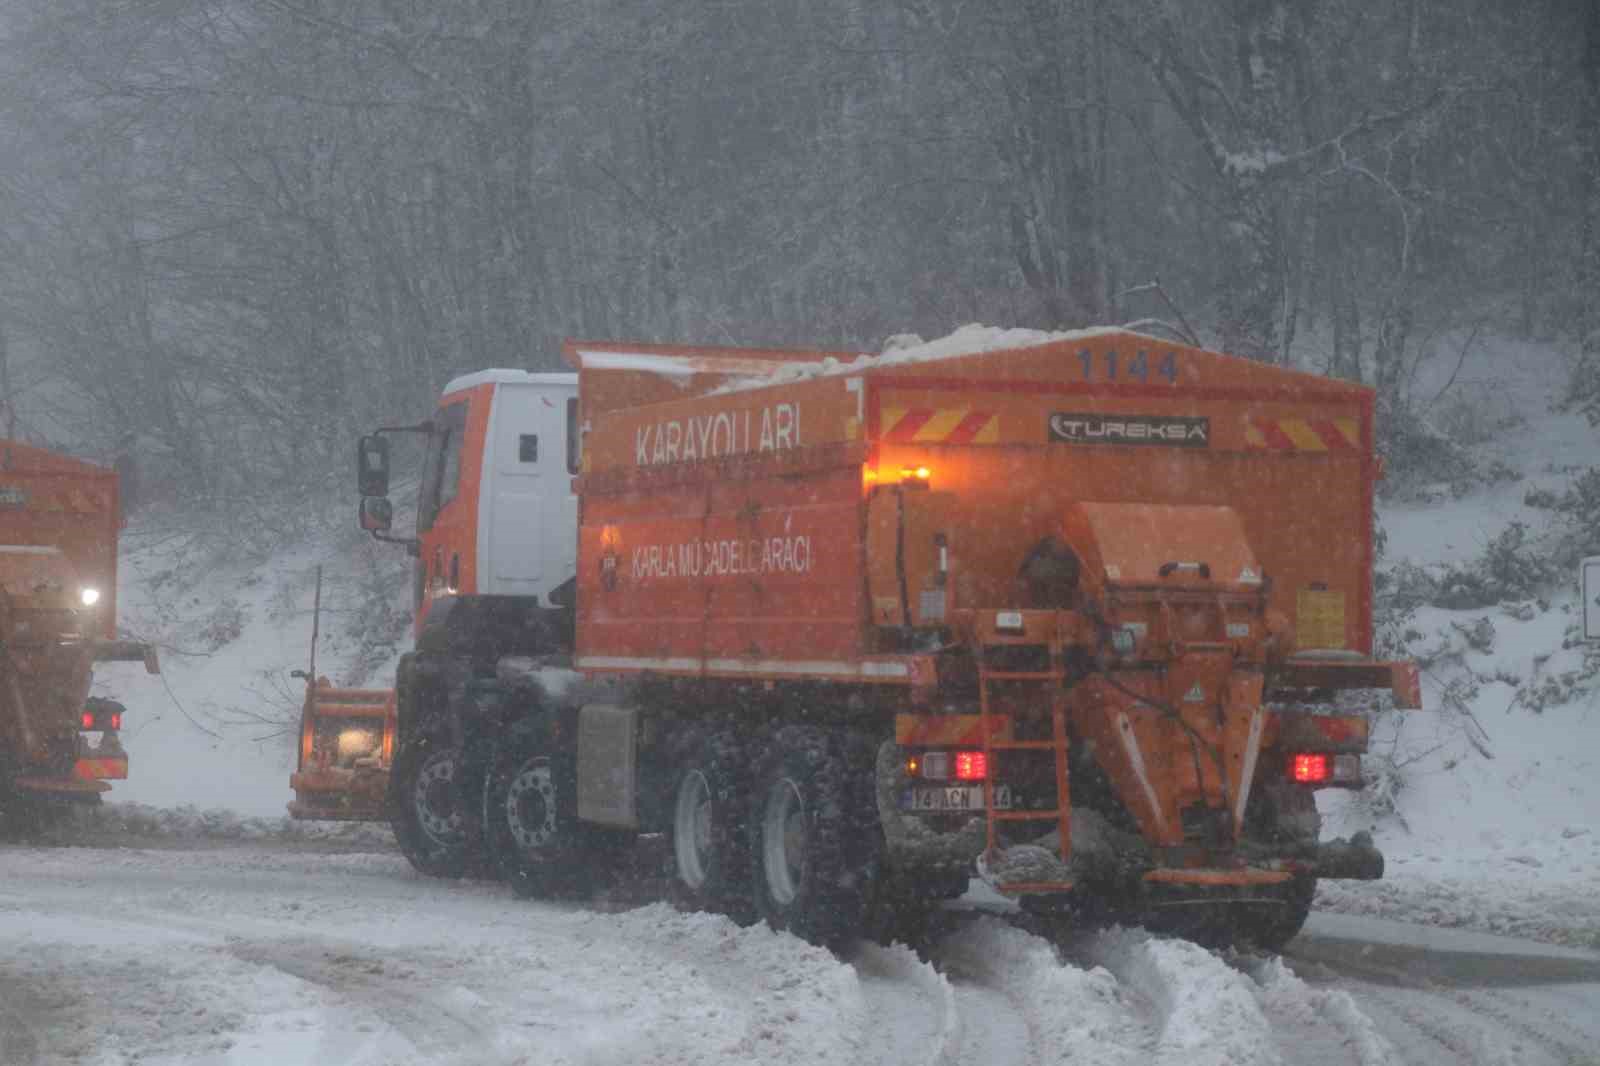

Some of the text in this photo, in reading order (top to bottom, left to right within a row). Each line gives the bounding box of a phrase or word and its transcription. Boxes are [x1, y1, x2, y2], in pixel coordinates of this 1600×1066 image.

[1076, 349, 1178, 383] 1144
[1060, 419, 1207, 441] TUREKSA
[632, 544, 677, 577] KARLA
[761, 535, 811, 574] ARACI
